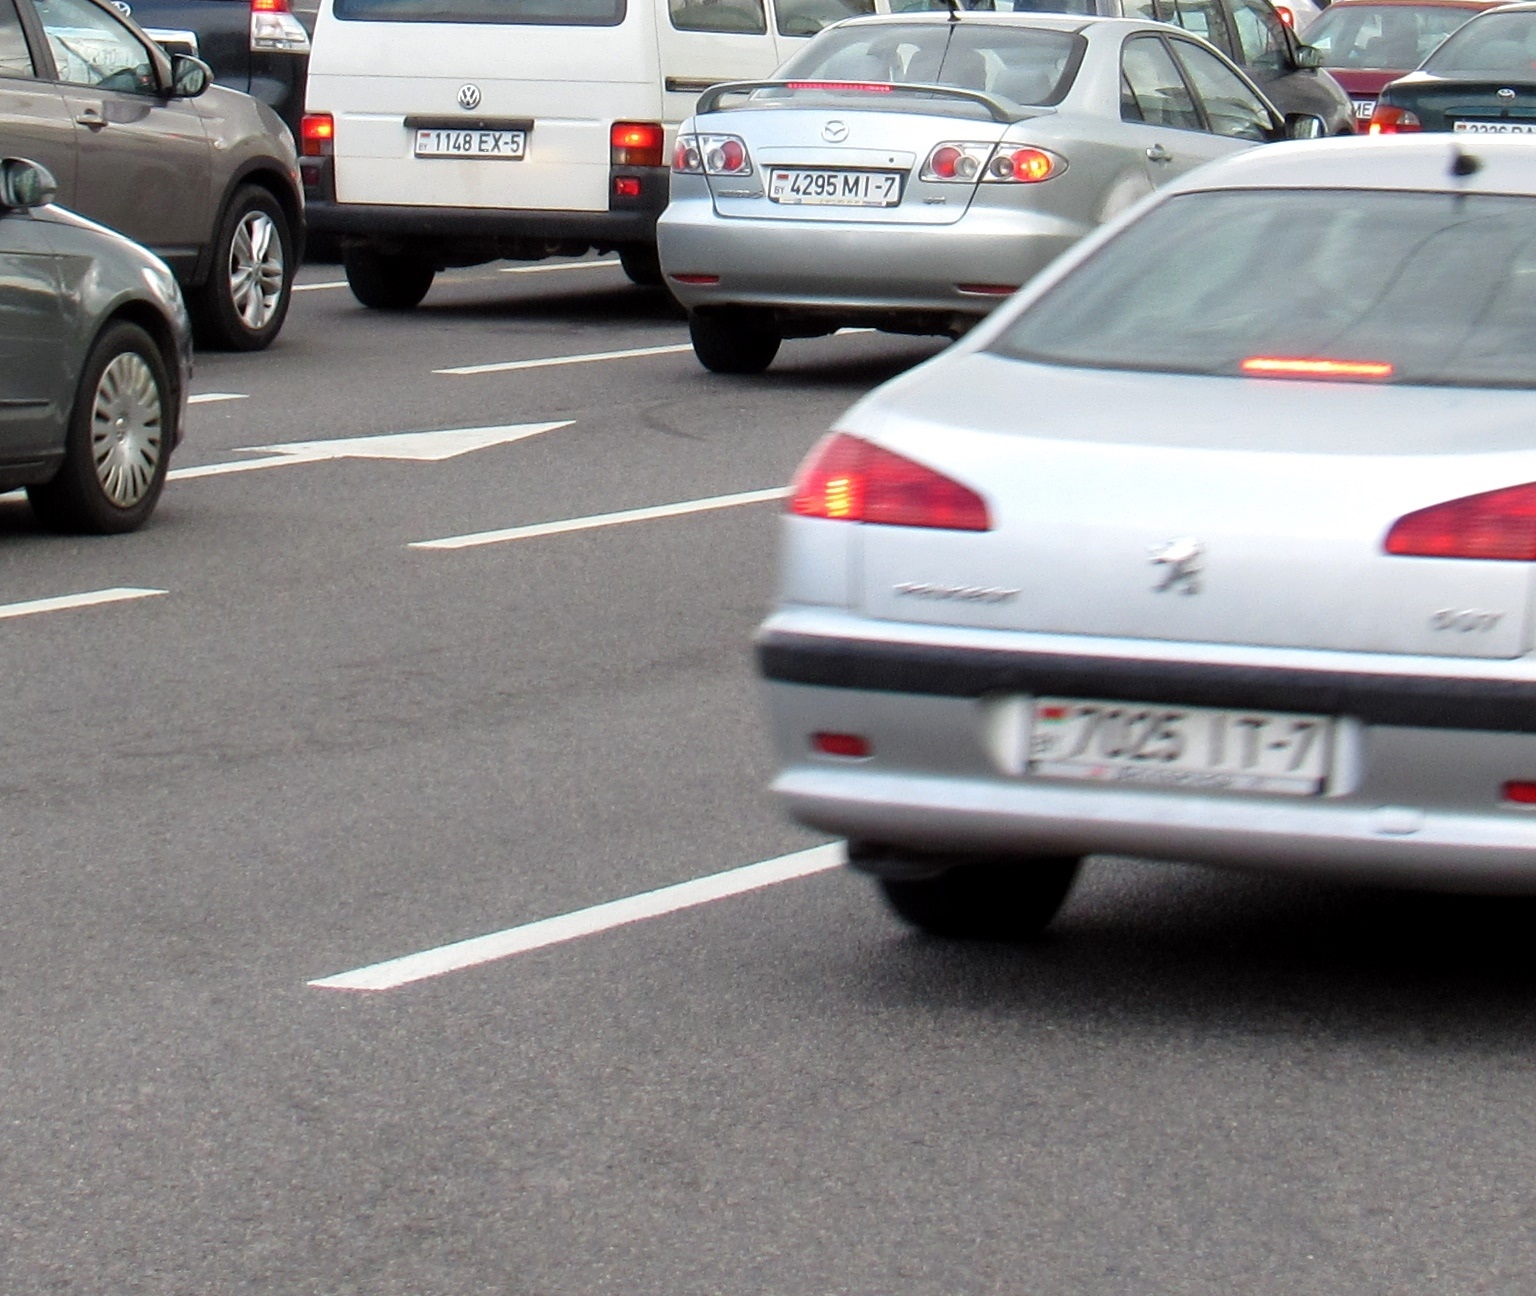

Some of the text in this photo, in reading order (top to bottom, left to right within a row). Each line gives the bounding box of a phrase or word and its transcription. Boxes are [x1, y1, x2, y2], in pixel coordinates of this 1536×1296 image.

[435, 132, 522, 153] 1148 EX-5
[790, 173, 839, 196] 4295
